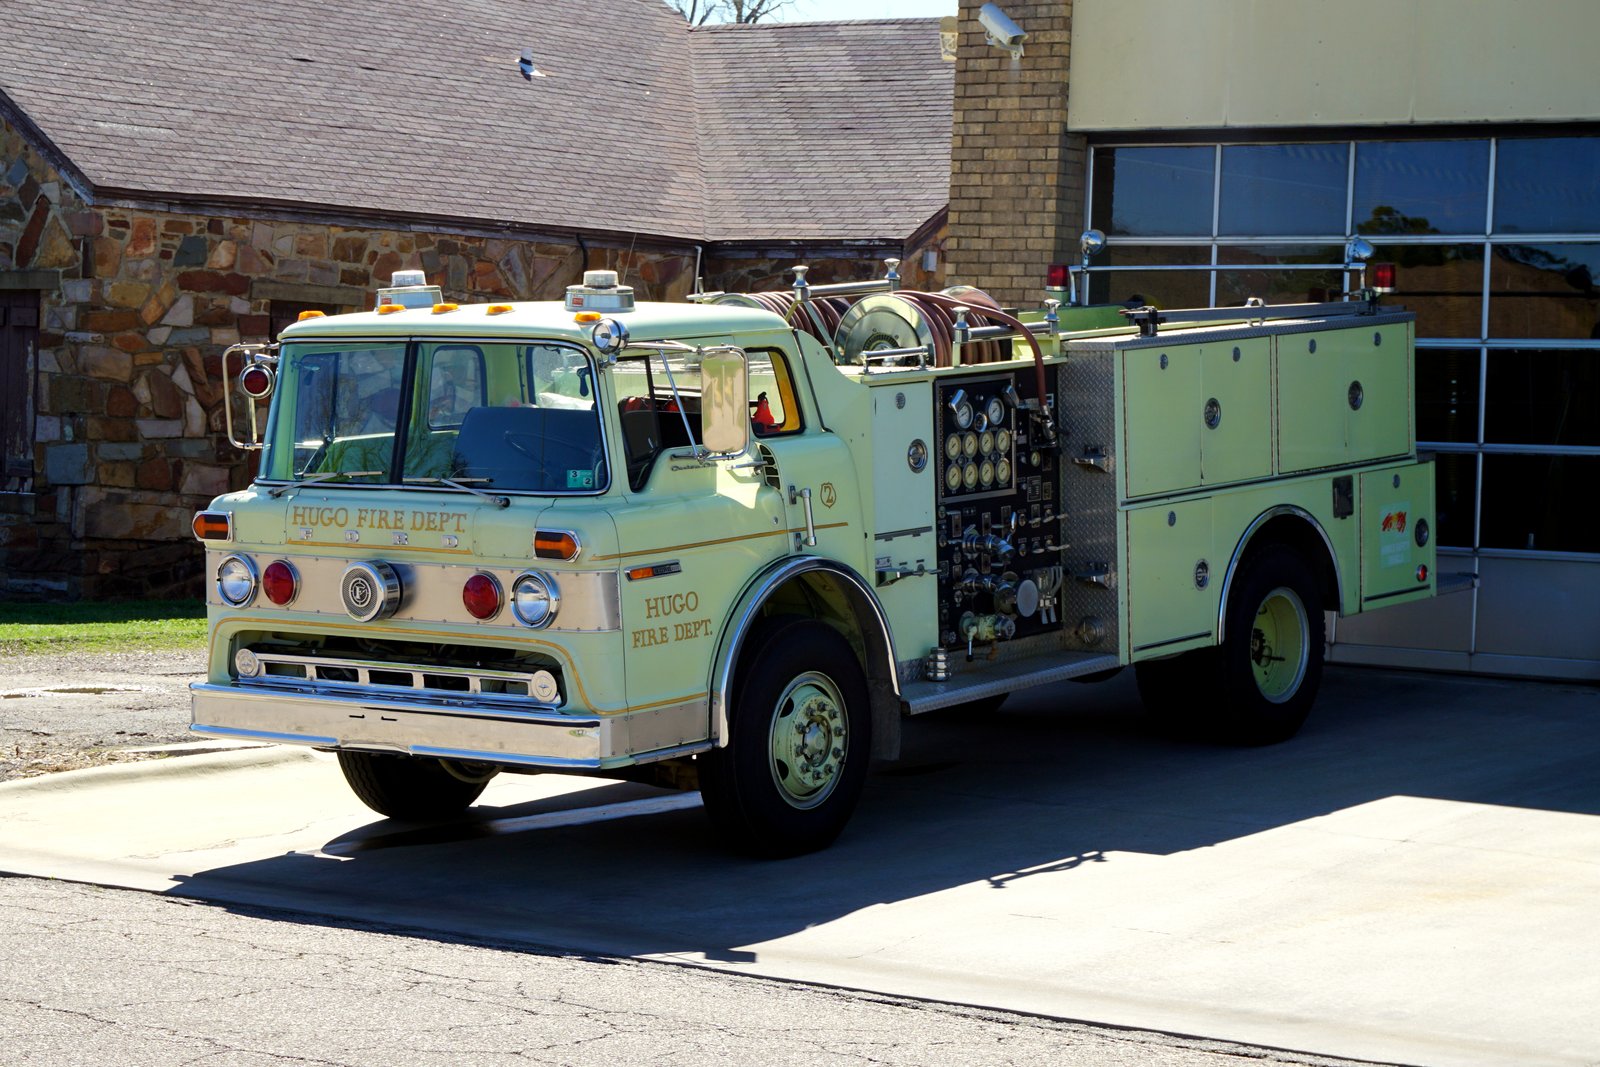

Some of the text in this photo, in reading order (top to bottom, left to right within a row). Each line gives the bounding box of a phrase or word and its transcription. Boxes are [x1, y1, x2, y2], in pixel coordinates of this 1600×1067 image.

[571, 470, 578, 478] 3
[584, 477, 591, 485] 2
[291, 505, 468, 533] HUGO FIRE DEPT.
[299, 527, 459, 548] FORD
[645, 591, 699, 619] HUGO
[632, 619, 713, 648] FIRE DEPT.
